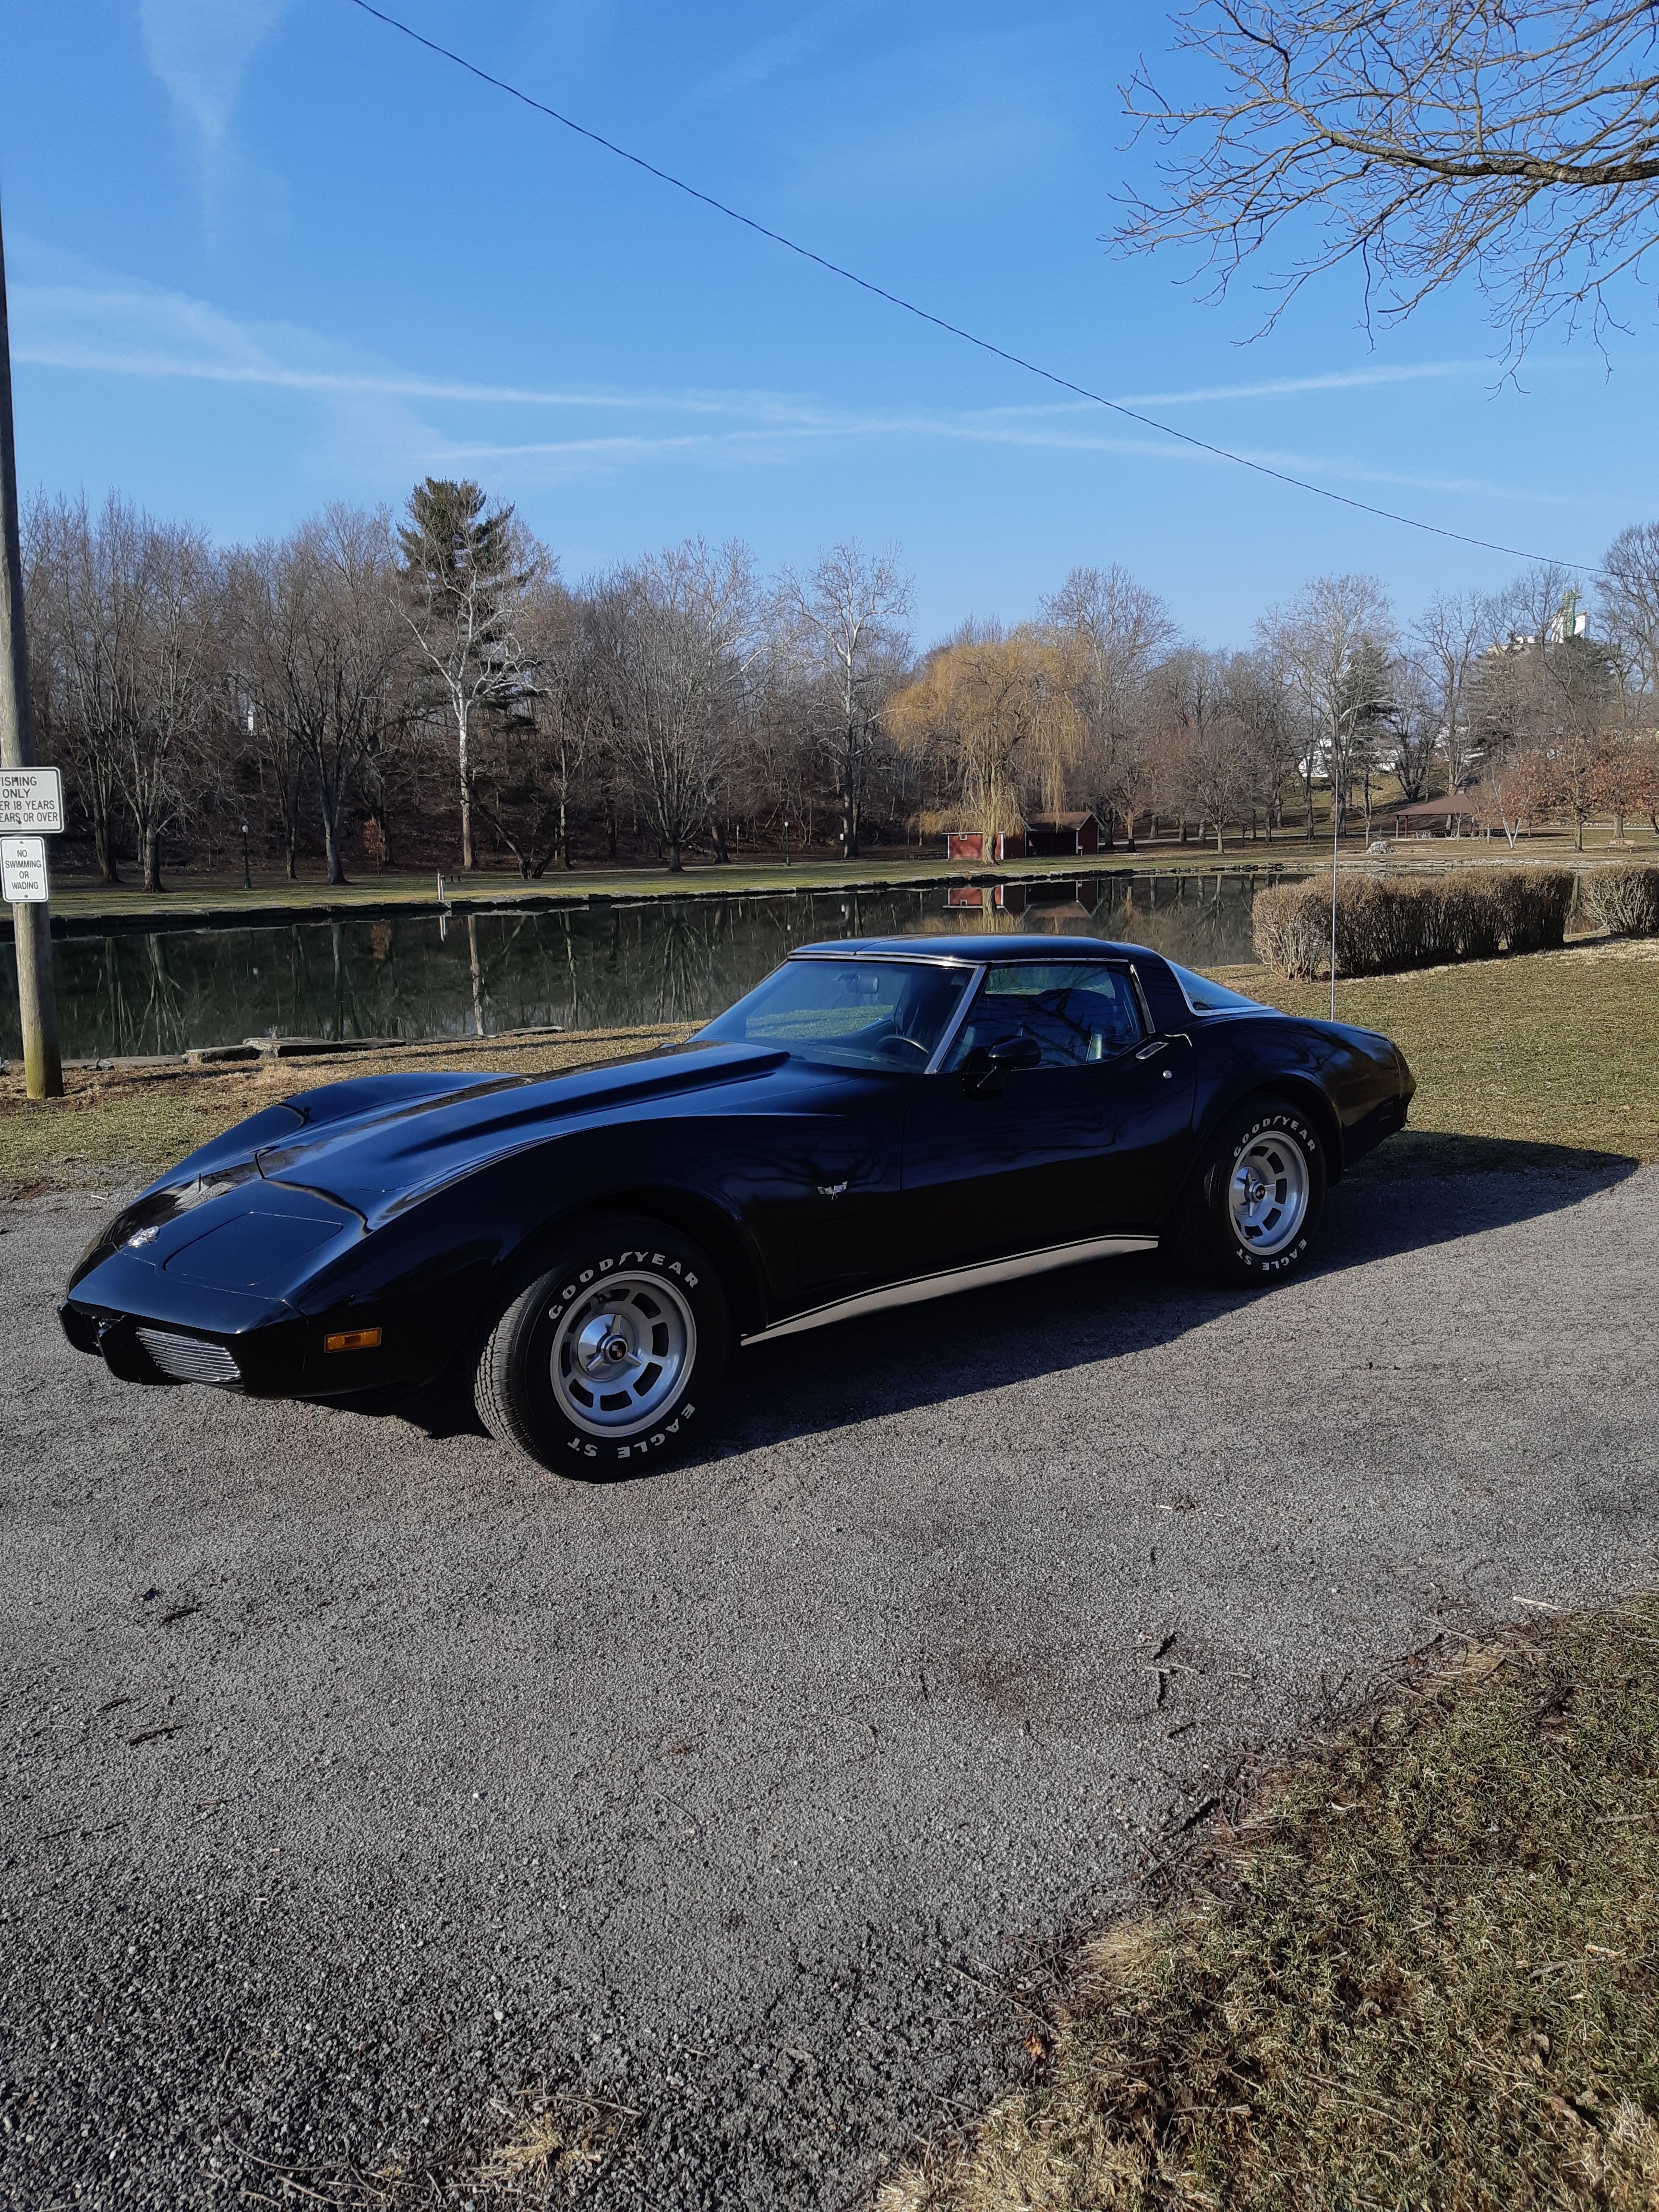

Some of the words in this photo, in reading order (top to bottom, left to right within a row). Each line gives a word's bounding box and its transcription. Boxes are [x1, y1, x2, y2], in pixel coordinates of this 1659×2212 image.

[0, 776, 37, 786] ISHING
[2, 788, 31, 798] ONLY
[13, 800, 22, 810] 18
[25, 800, 55, 810] YEARS
[23, 812, 34, 822] OR
[37, 812, 58, 821] OVER
[17, 849, 27, 857] NO
[5, 860, 41, 868] SWIMMING
[19, 871, 29, 879] OR
[12, 881, 39, 890] WADING
[1233, 1115, 1315, 1158] GOODYEAR
[1236, 1249, 1252, 1265] ST
[1262, 1238, 1307, 1271] EAGLE
[548, 1251, 699, 1320] GOODYEAR
[617, 1403, 696, 1458] EAGLE
[567, 1437, 598, 1457] ST
